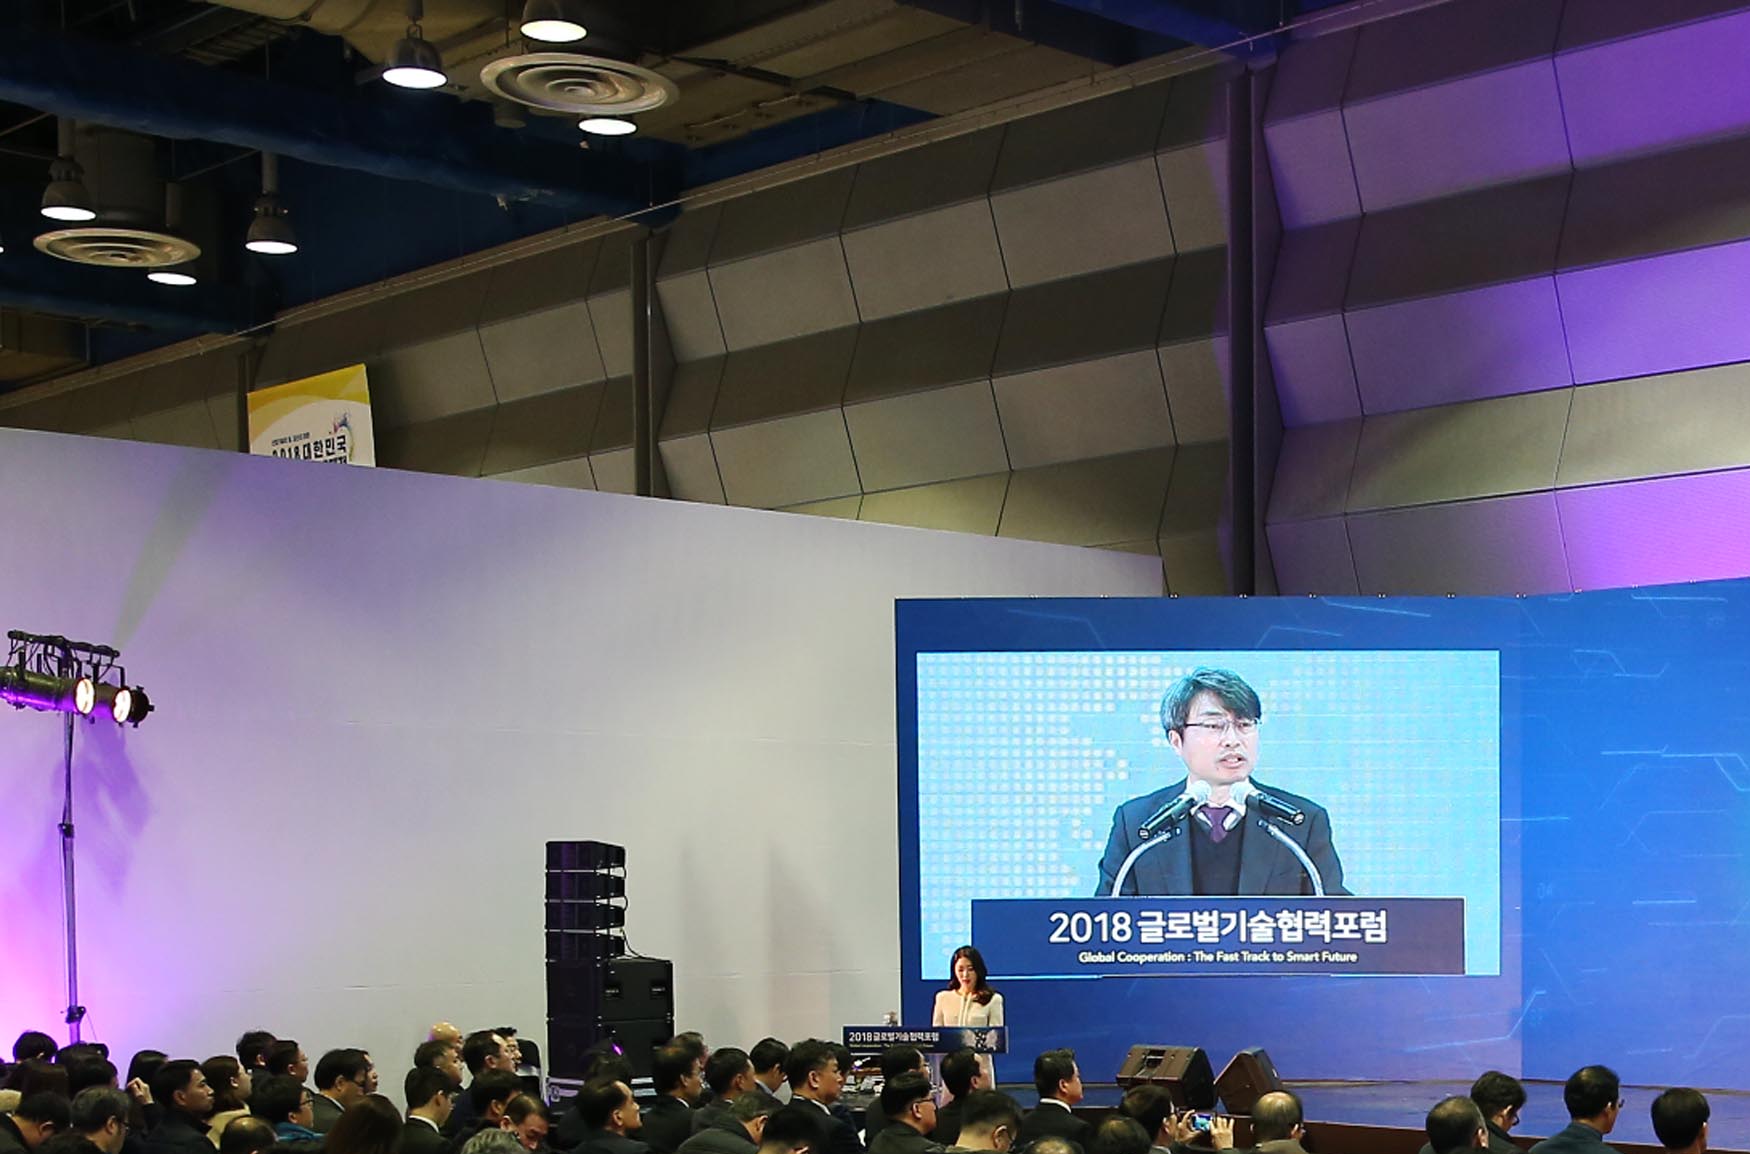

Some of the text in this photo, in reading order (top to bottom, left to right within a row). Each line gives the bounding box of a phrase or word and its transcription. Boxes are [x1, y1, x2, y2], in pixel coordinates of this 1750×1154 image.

[303, 435, 347, 460] 대한민국
[1048, 909, 1388, 944] 2018 글로벌기술협력포럼
[1078, 951, 1115, 963] Global
[1117, 951, 1185, 965] Cooperation
[1193, 951, 1214, 962] The
[1216, 951, 1239, 962] Fast
[1241, 951, 1270, 962] Track
[1272, 951, 1285, 962] to
[1287, 951, 1320, 962] Smart
[1321, 951, 1358, 963] Future
[849, 1032, 873, 1042] 2018
